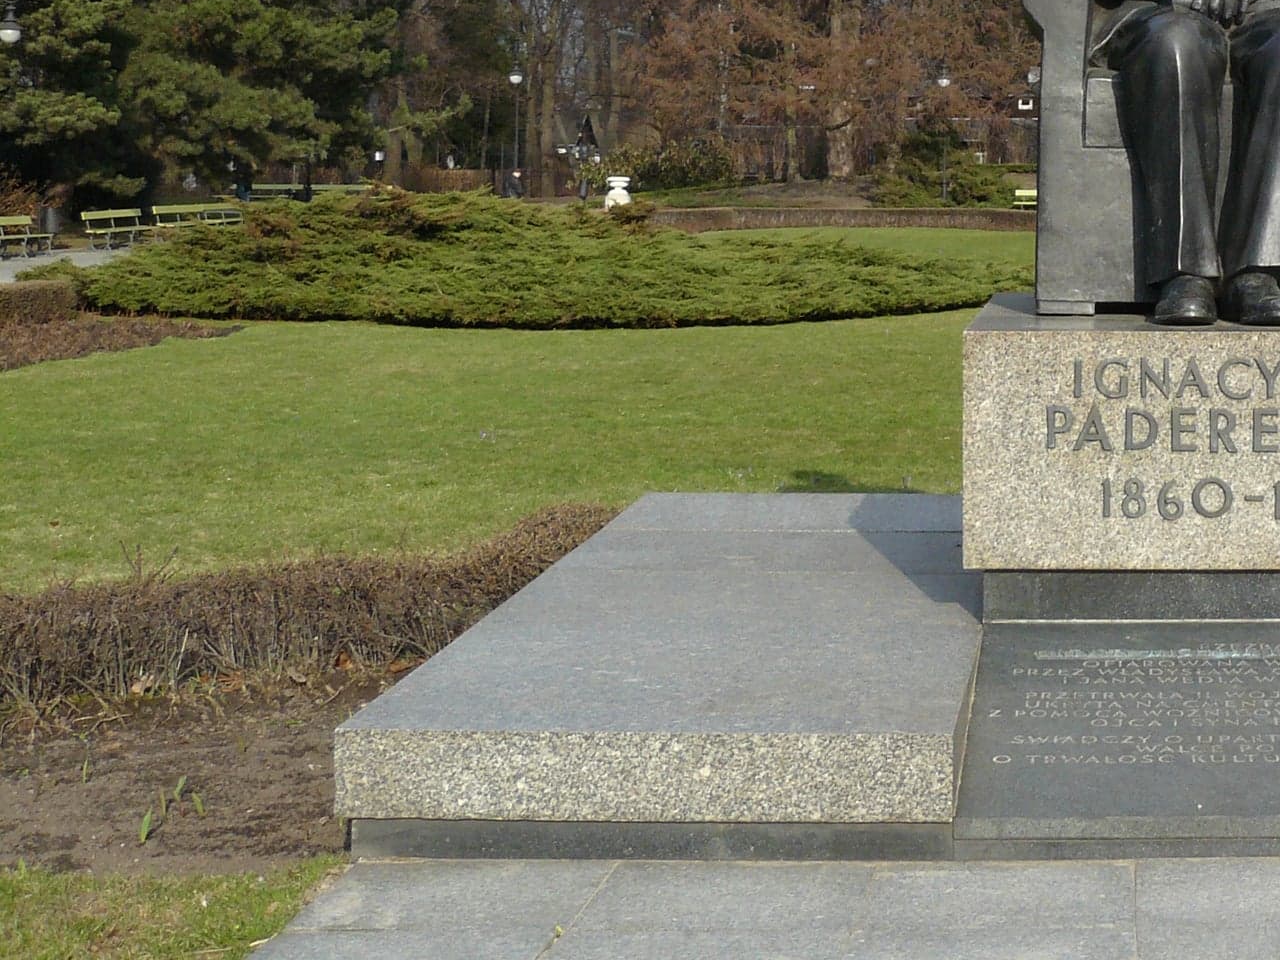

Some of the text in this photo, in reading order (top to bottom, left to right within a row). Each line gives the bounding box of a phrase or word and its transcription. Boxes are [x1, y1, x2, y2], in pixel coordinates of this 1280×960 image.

[1082, 659, 1251, 668] OFIAROWANA
[1012, 668, 1086, 676] PRZEZ
[1079, 676, 1145, 685] JANA
[1136, 700, 1169, 708] NA
[1090, 718, 1161, 727] OJCA
[1191, 718, 1258, 727] SYNA
[992, 754, 1012, 764] O
